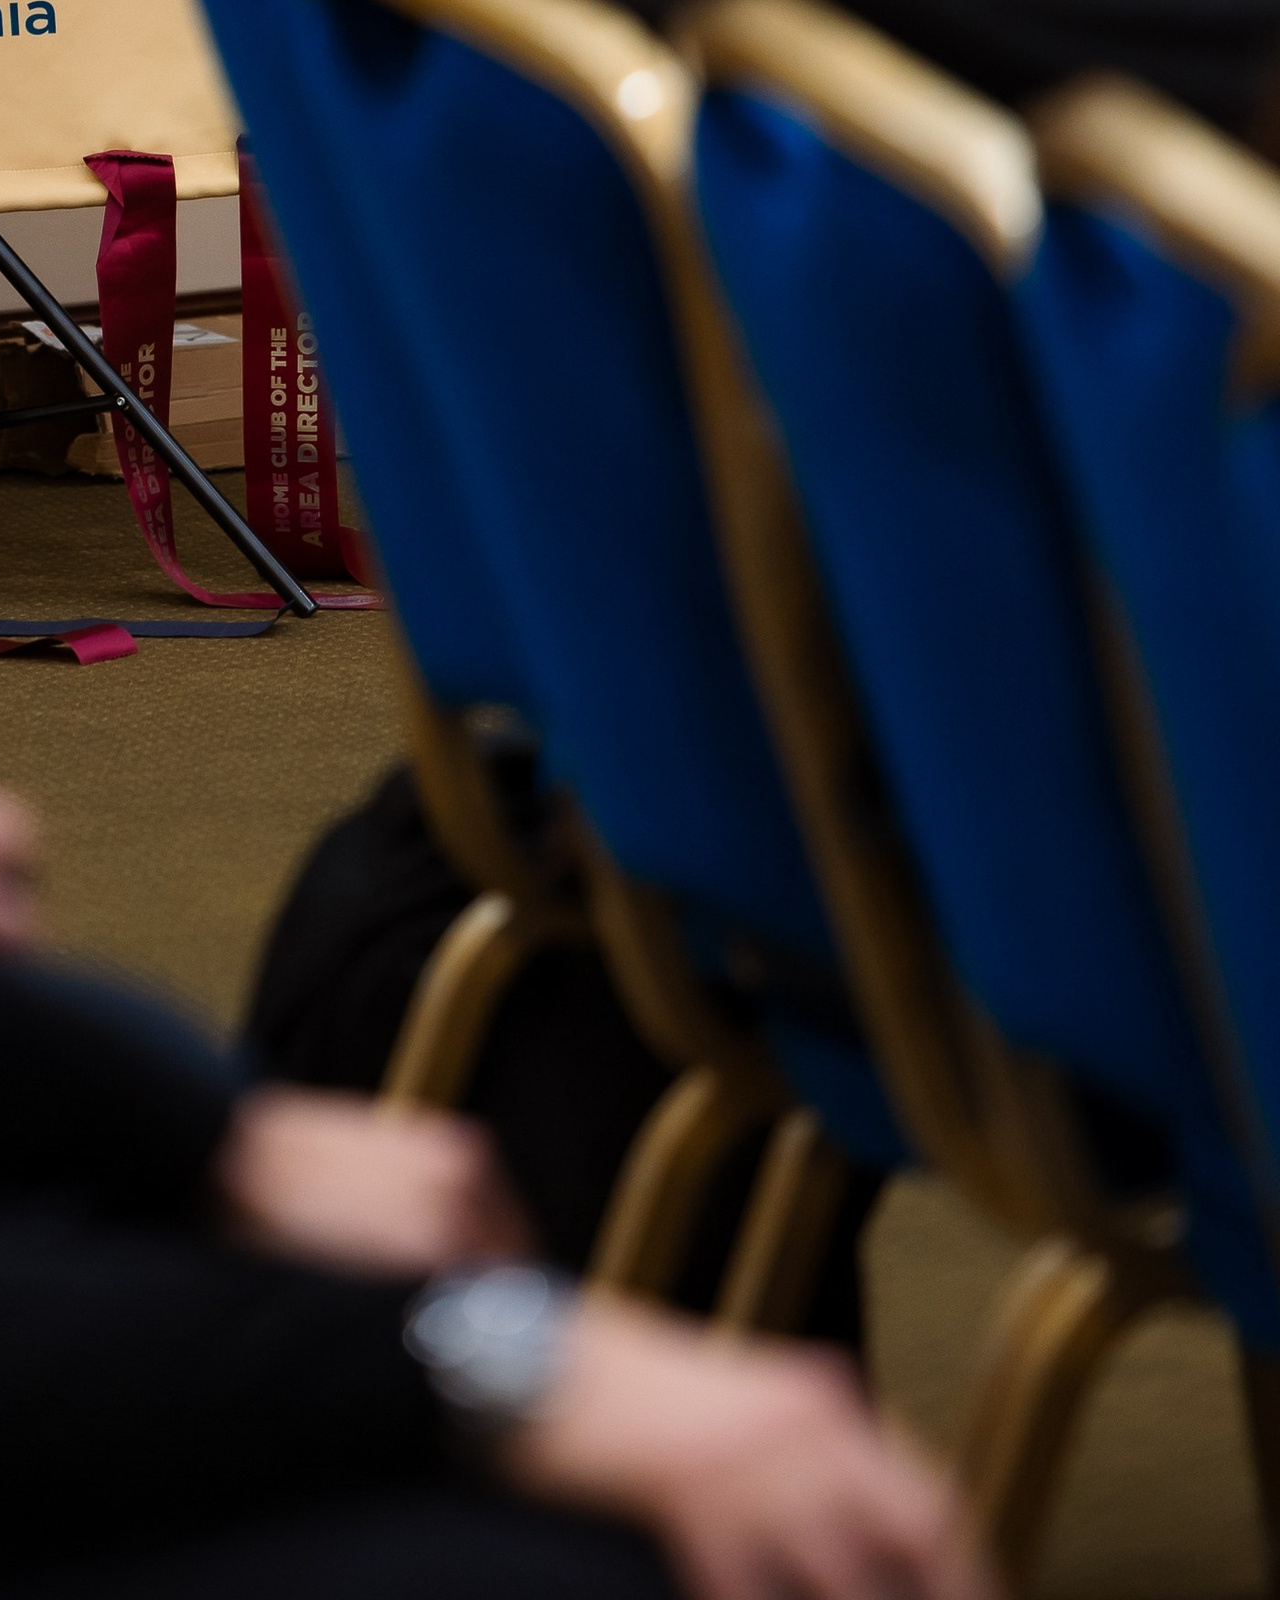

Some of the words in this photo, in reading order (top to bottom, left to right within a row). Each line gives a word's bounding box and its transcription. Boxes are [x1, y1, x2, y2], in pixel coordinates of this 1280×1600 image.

[270, 327, 288, 371] THE
[137, 342, 161, 494] DIRTOR
[270, 375, 287, 406] OF
[271, 412, 288, 468] CLUB
[272, 472, 292, 532] HOME
[297, 471, 324, 548] AREA
